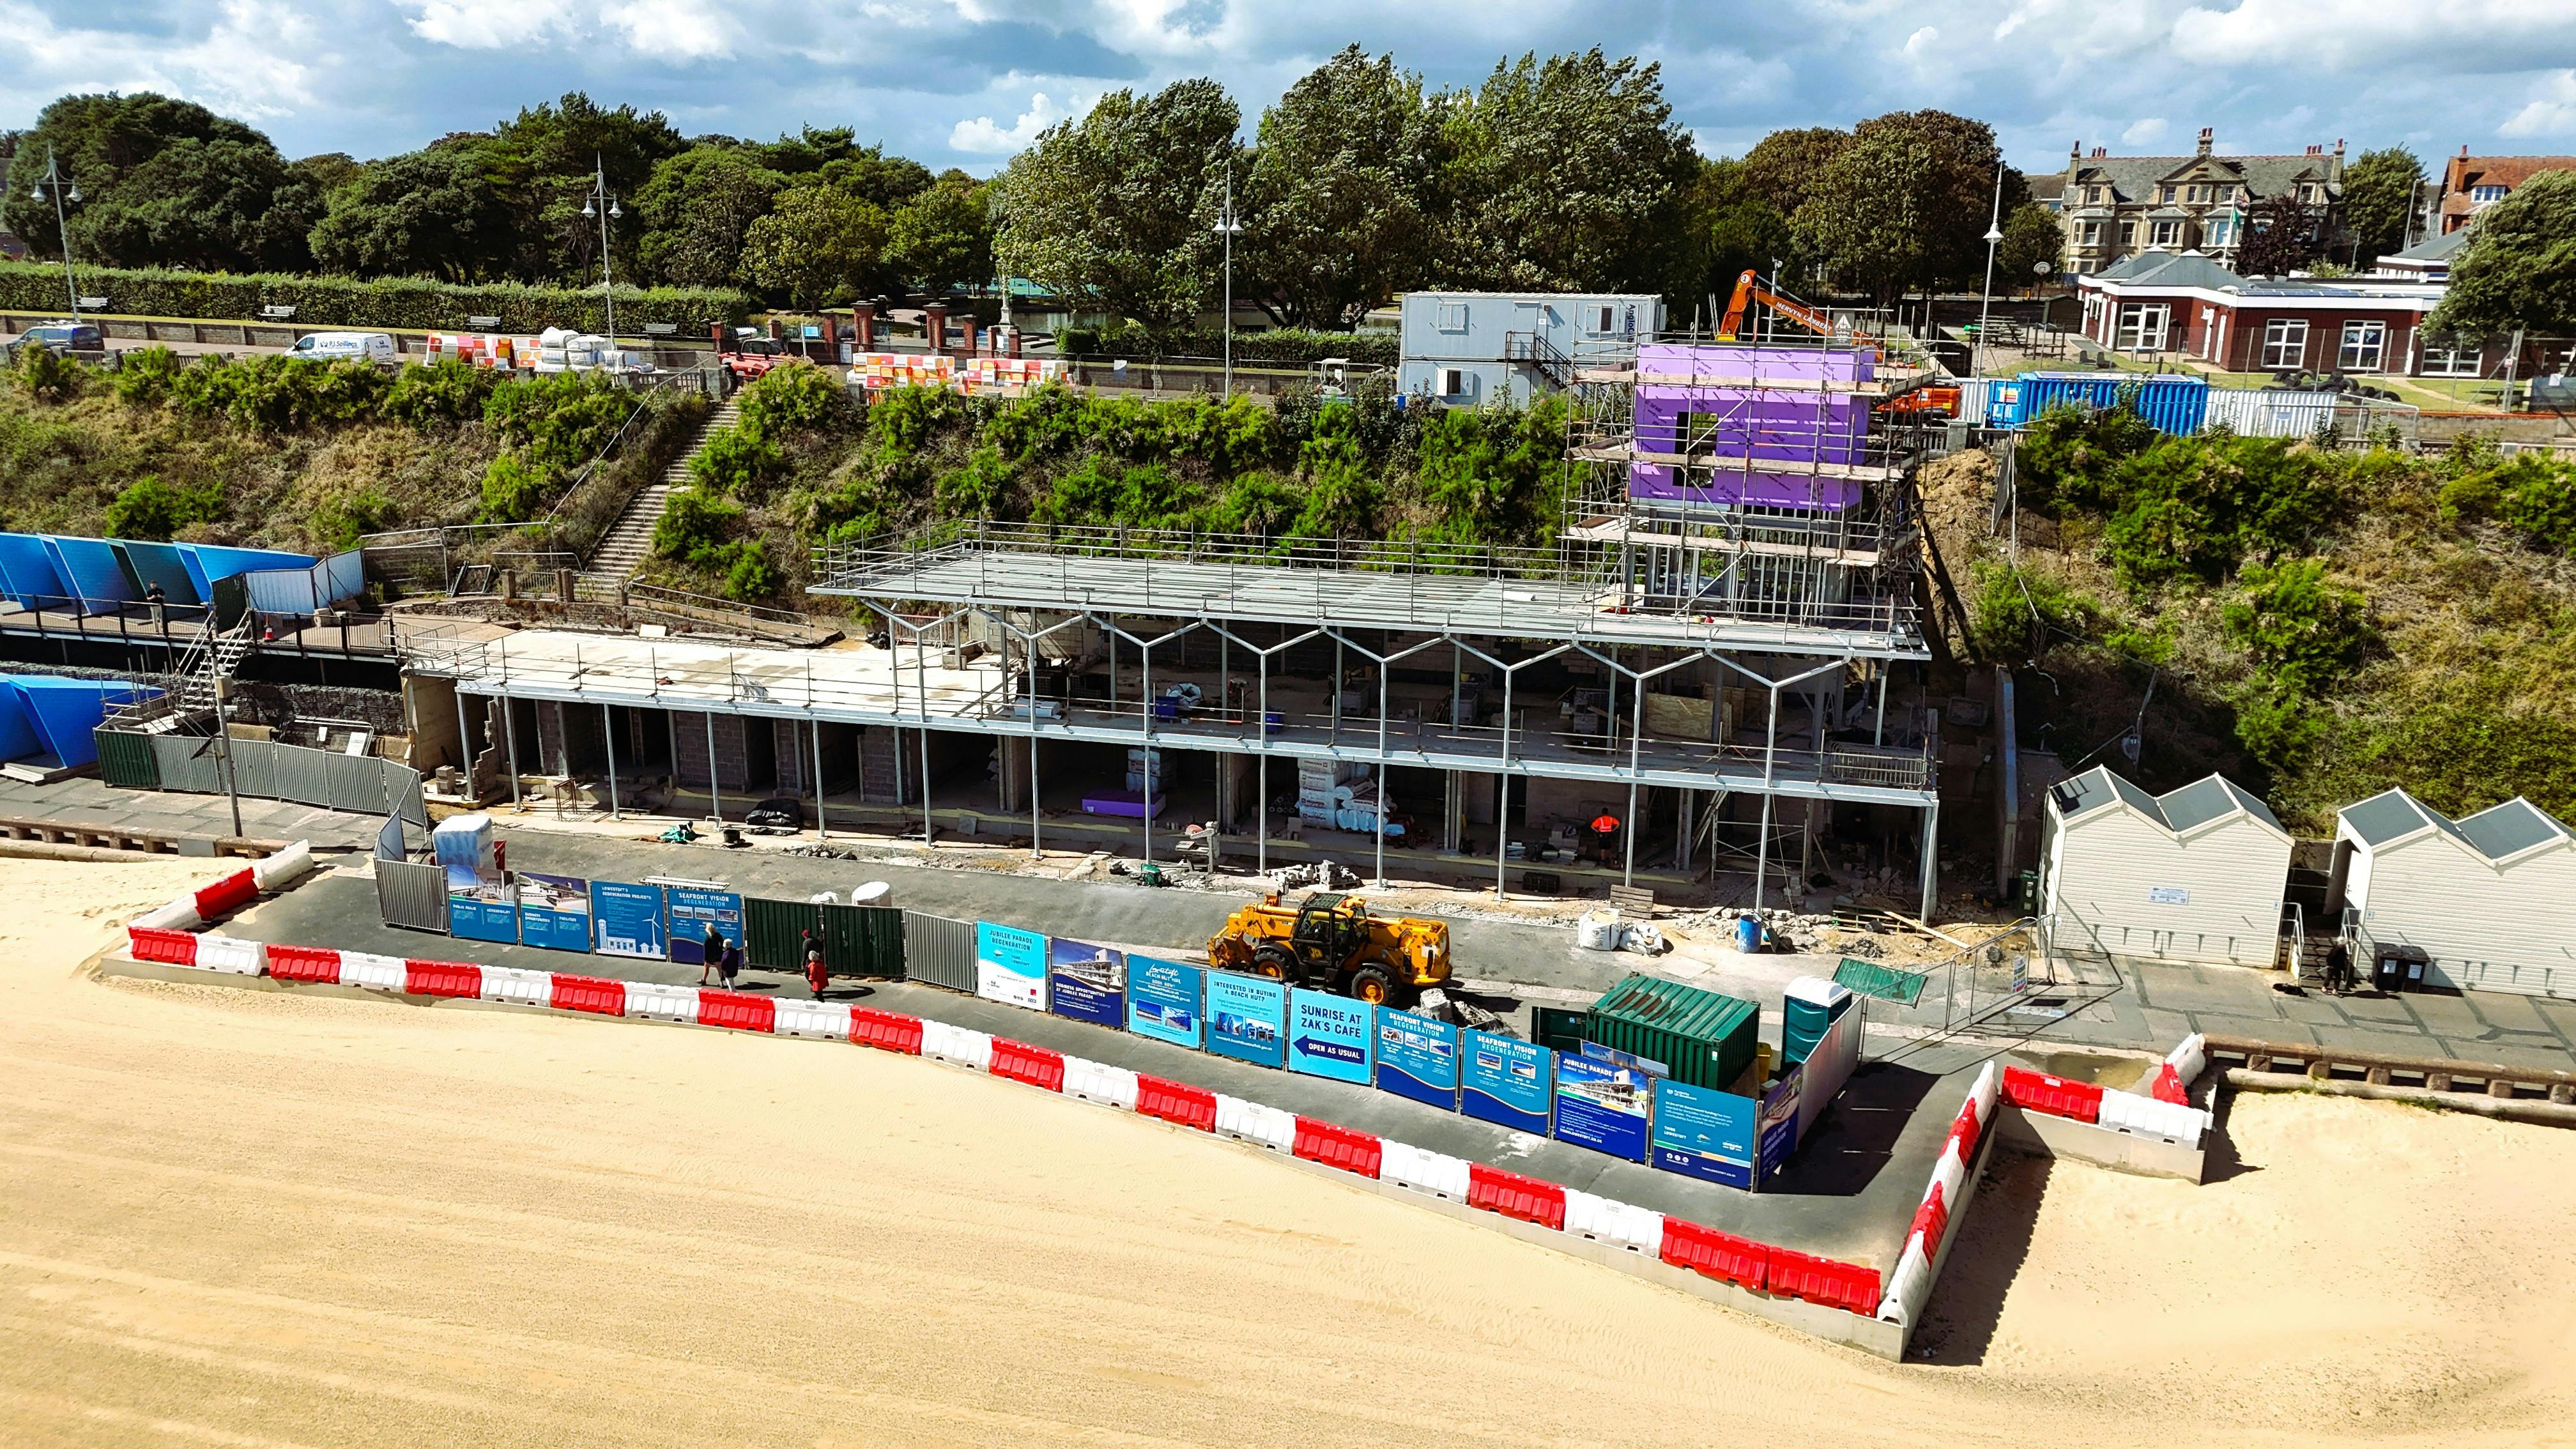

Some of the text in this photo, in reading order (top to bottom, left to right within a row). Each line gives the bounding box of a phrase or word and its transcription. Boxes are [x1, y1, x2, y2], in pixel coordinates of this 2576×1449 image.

[1775, 301, 1802, 318] MERVYN
[678, 893, 708, 901] SEAFRONT
[683, 898, 726, 907] REGENERATION
[989, 930, 1033, 944] JUBILEE PARADE
[992, 937, 1031, 951] REGENERATION
[1214, 981, 1246, 992] INTERESTED
[1256, 989, 1276, 998] BUYING
[1230, 990, 1248, 999] BEACH
[1250, 994, 1265, 1002] HUT?
[1301, 1004, 1362, 1025] SUNRISE AT
[1388, 1012, 1445, 1033] SEAFRONT VISION
[1301, 1017, 1361, 1038] ZAK'S CAFÉ
[1393, 1020, 1440, 1038] REGENERATION
[1308, 1043, 1325, 1053] OPEN
[1338, 1048, 1360, 1059] USUAL
[1476, 1034, 1537, 1056] SEAFRONT VISION
[1482, 1043, 1532, 1061] REGENERATION
[1563, 1058, 1613, 1077] JUBILEE PARADE
